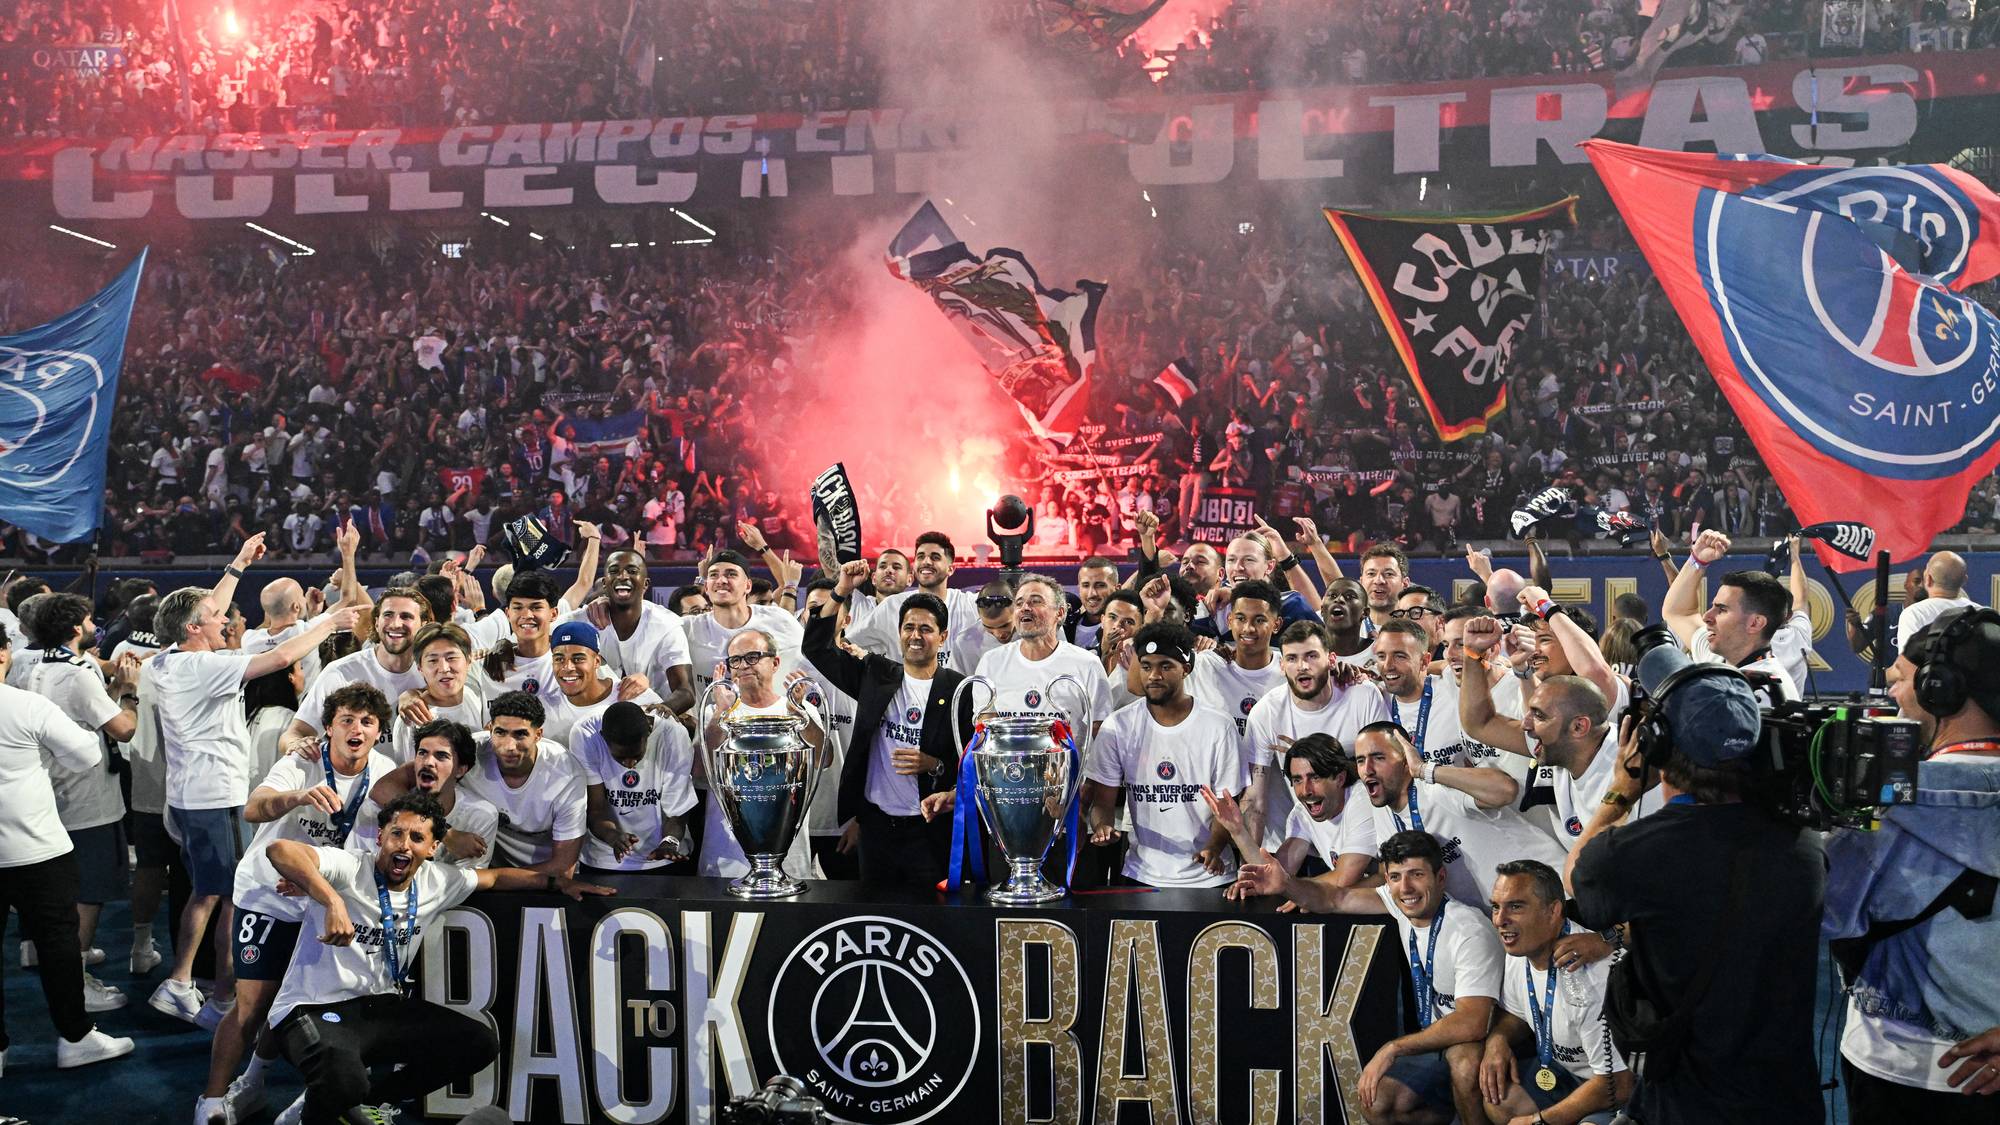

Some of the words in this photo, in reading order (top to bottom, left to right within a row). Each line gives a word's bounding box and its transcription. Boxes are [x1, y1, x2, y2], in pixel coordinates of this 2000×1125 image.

[33, 49, 109, 68] QATAR
[1128, 64, 1919, 185] ULTRAS
[1553, 256, 1618, 277] ATAR
[1848, 392, 1952, 427] SAINT
[533, 542, 549, 560] 2025
[1433, 743, 1463, 758] GOING
[617, 789, 643, 800] NEVER
[1146, 793, 1157, 803] BE
[1159, 793, 1179, 803] JUST
[1153, 784, 1181, 794] NEVER
[1181, 784, 1204, 794] GOIN
[621, 799, 640, 808] JUST
[238, 913, 276, 945] 87
[802, 925, 942, 978] PARIS
[421, 905, 767, 1125] BACK
[627, 999, 677, 1038] TO
[995, 917, 1387, 1125] BACK
[806, 1068, 854, 1108] SAINT
[869, 1072, 944, 1113] GERMAIN
